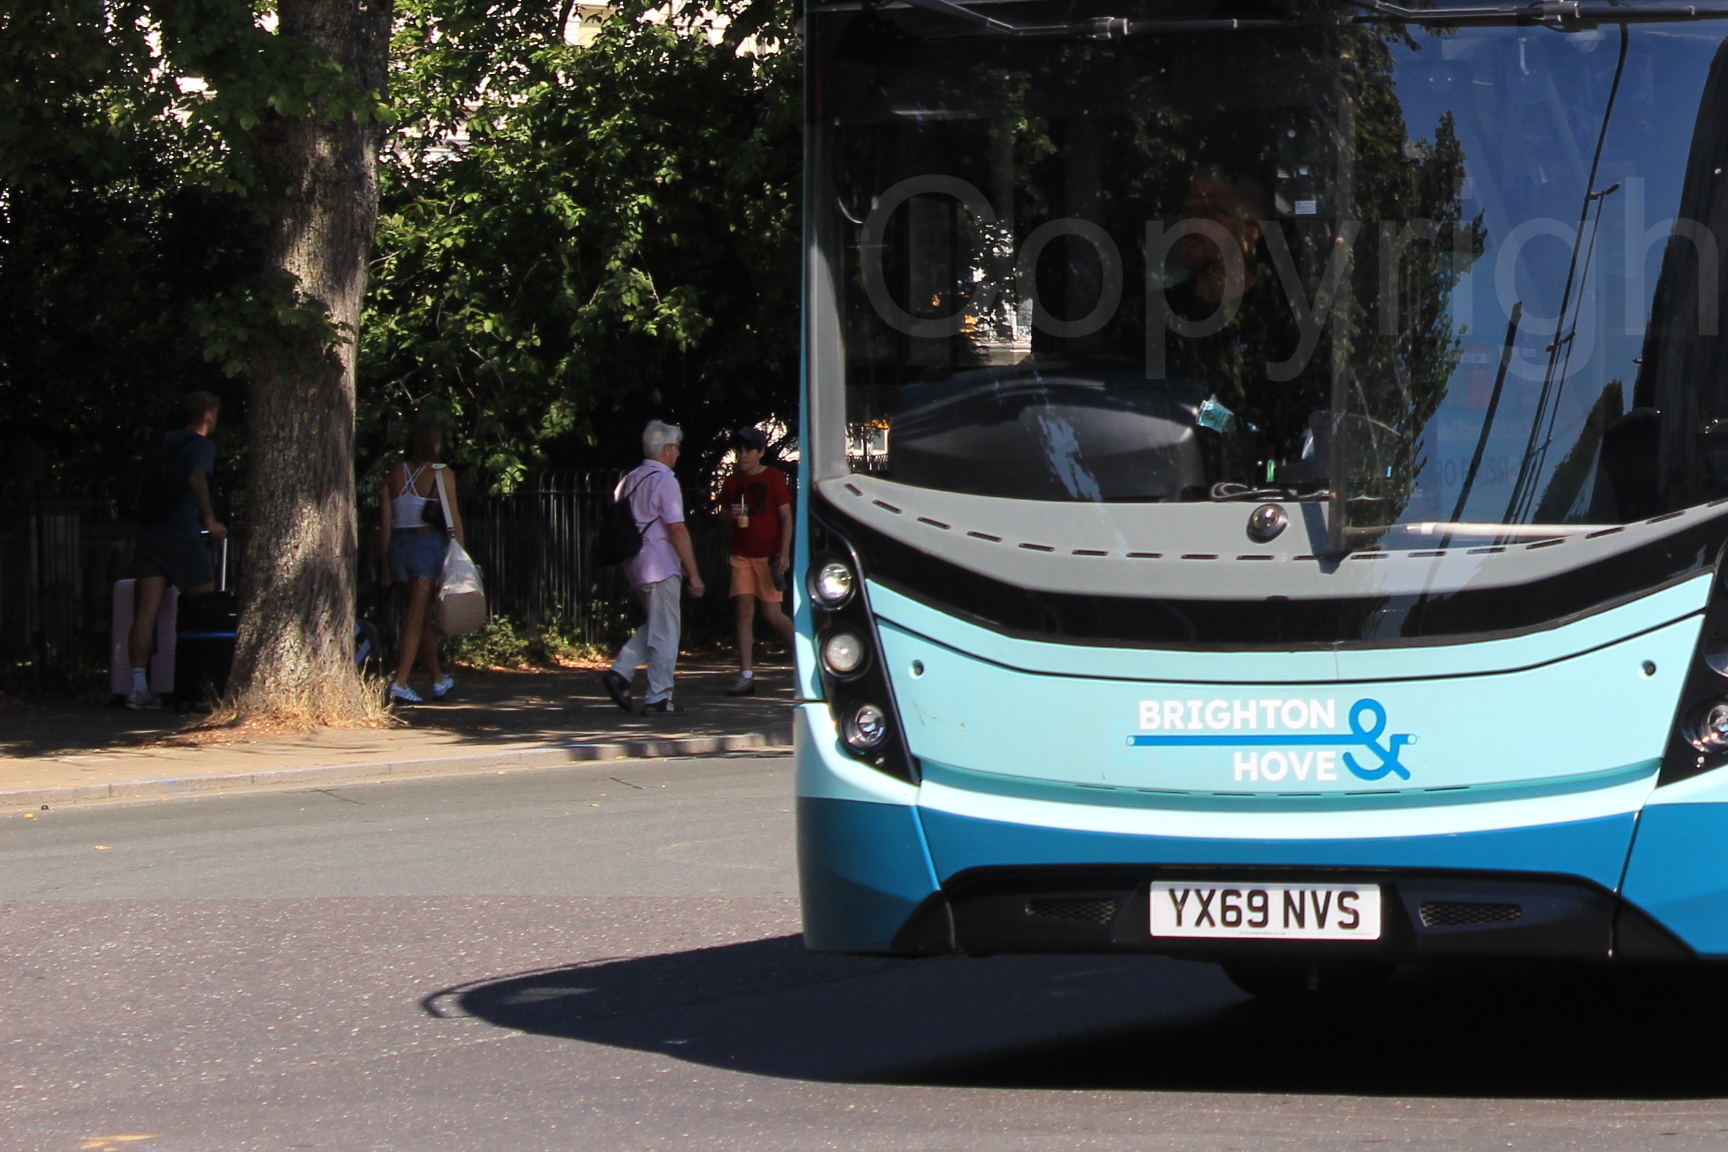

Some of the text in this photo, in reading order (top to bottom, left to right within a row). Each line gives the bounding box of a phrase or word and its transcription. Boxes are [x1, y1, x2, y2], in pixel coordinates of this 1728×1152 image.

[1138, 698, 1336, 730] BRIGHTON
[1233, 750, 1338, 781] HOVE
[1168, 888, 1360, 930] YX69 NVS
